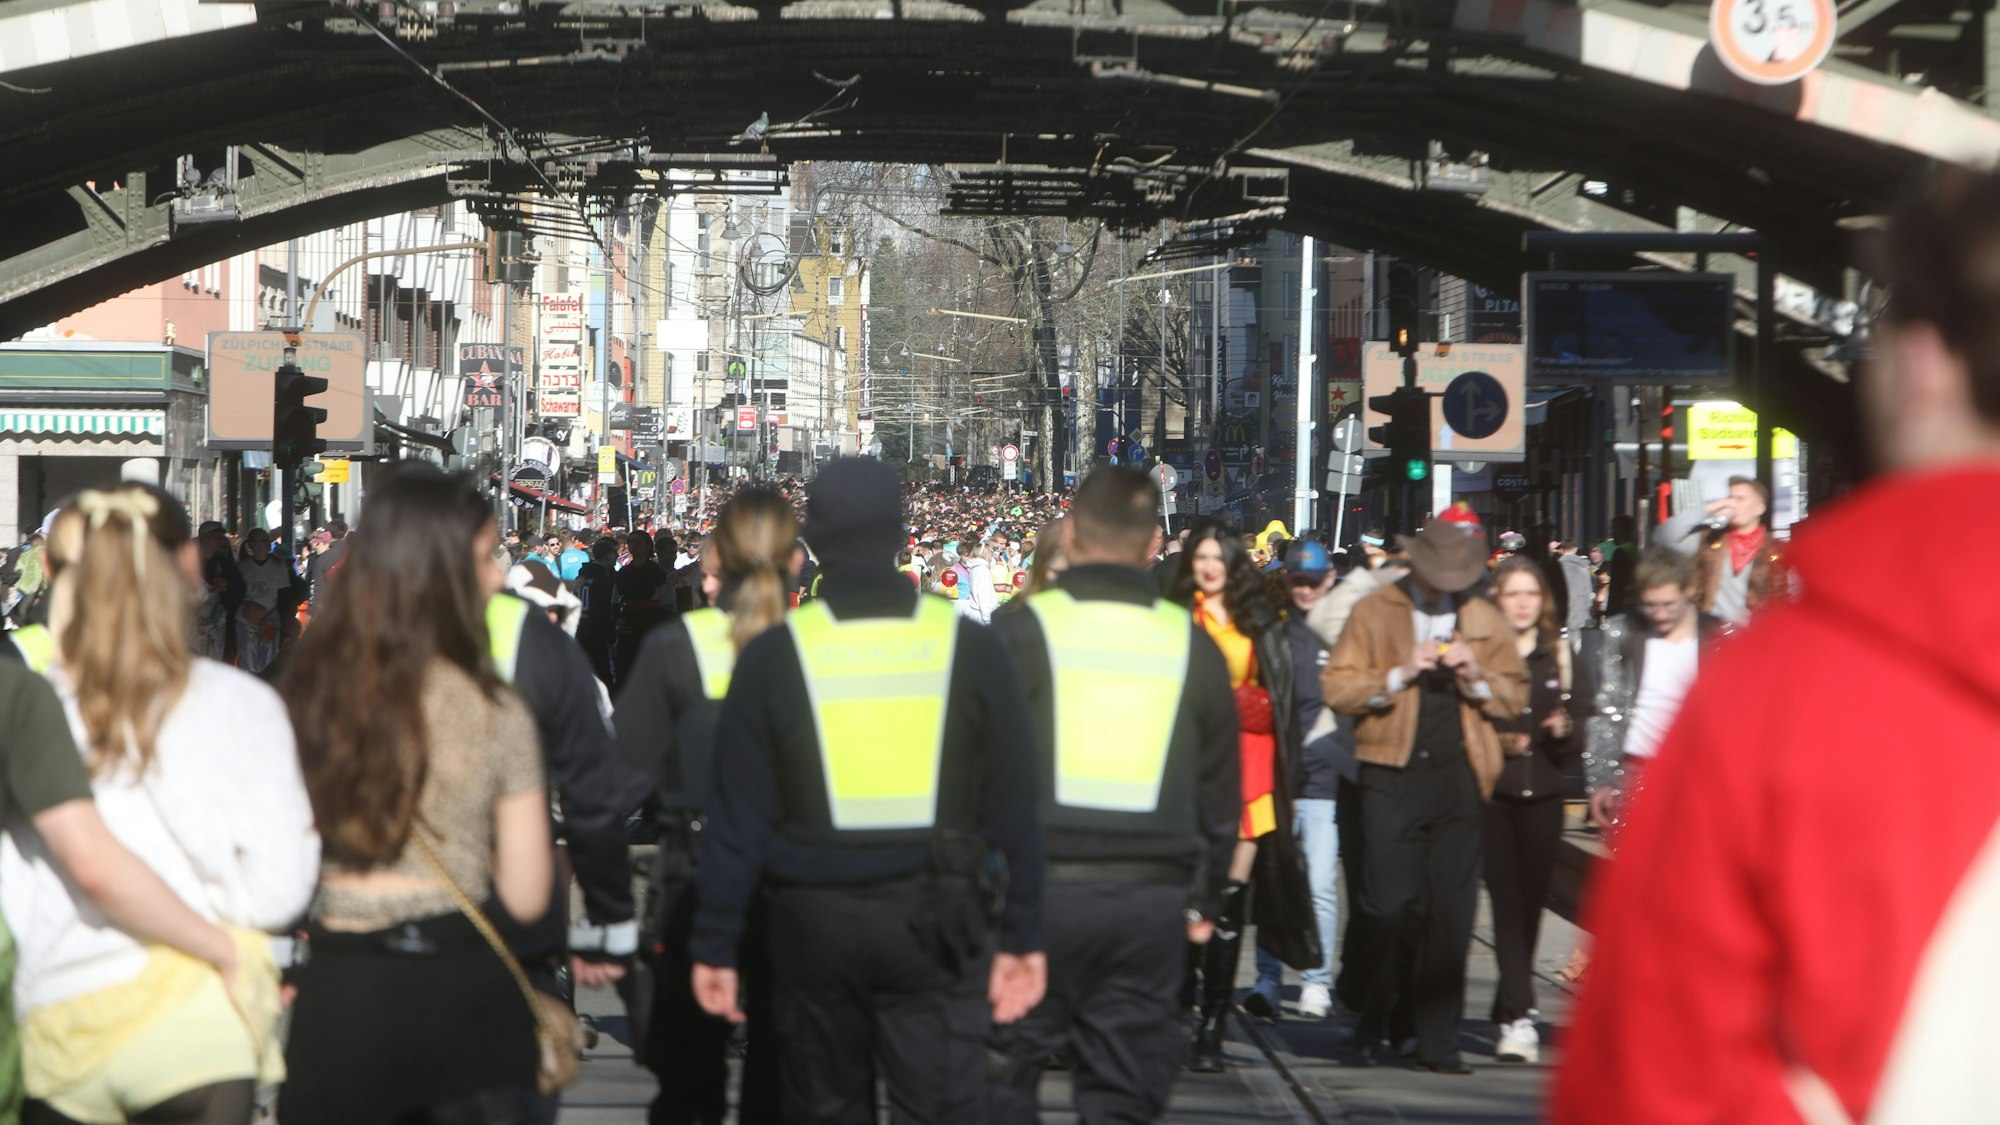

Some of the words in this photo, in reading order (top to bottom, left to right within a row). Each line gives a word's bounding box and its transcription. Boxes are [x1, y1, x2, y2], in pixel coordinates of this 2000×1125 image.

[543, 296, 582, 312] Falafel
[1484, 299, 1520, 312] PITA
[243, 353, 332, 372] ZUGNG
